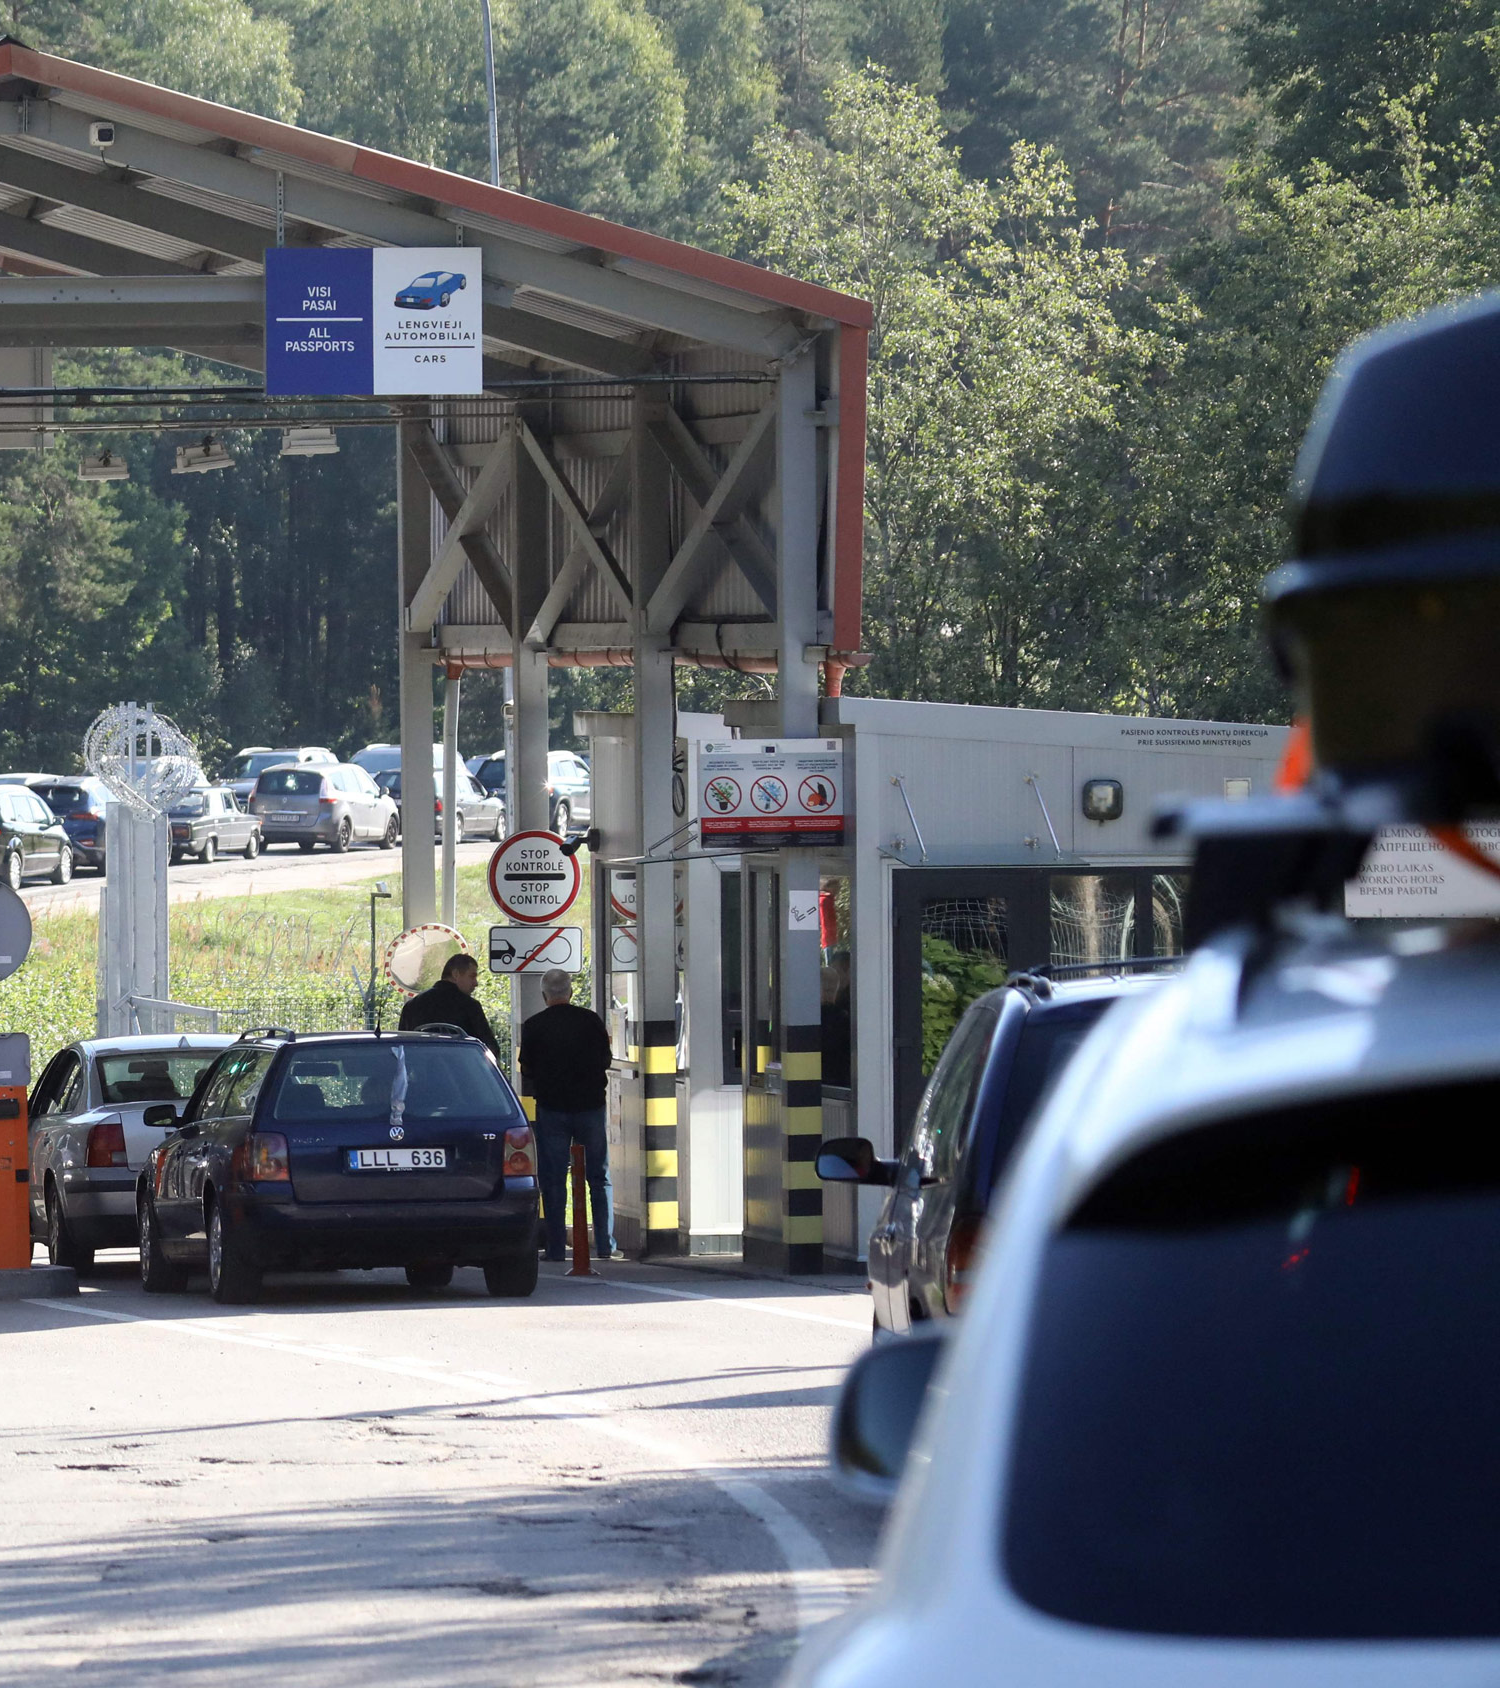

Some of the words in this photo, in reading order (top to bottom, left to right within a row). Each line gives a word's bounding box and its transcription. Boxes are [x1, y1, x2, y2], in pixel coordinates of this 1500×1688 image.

[307, 286, 331, 298] VISI
[302, 300, 337, 311] PASAI
[398, 320, 462, 329] LENGVIEJI
[308, 327, 331, 338] ALL
[385, 332, 476, 341] AUTOMOBILIAI
[285, 340, 355, 352] PASSPORTS
[414, 355, 447, 363] CARS
[1156, 728, 1199, 736] KONTROLĖS
[1201, 729, 1231, 737] PUNKTŲ
[1233, 730, 1268, 738] DIREKCIJA
[1202, 739, 1252, 747] MINISTERIJOS
[1372, 842, 1445, 852] ЗАПРЕЩЕНО
[521, 850, 550, 859] STOP
[506, 859, 564, 871] KONTROLĖ
[1359, 863, 1395, 873] DARBO
[1397, 863, 1434, 873] LAIKAS
[1359, 875, 1408, 884] WORKING
[1410, 875, 1445, 884] HOURS
[521, 883, 550, 892] STOP
[1360, 886, 1394, 896] ВРЕМЯ
[1396, 886, 1438, 896] РАБОТЫ
[509, 895, 561, 905] CONTROL
[360, 1151, 399, 1167] LLL
[411, 1150, 444, 1166] 636
